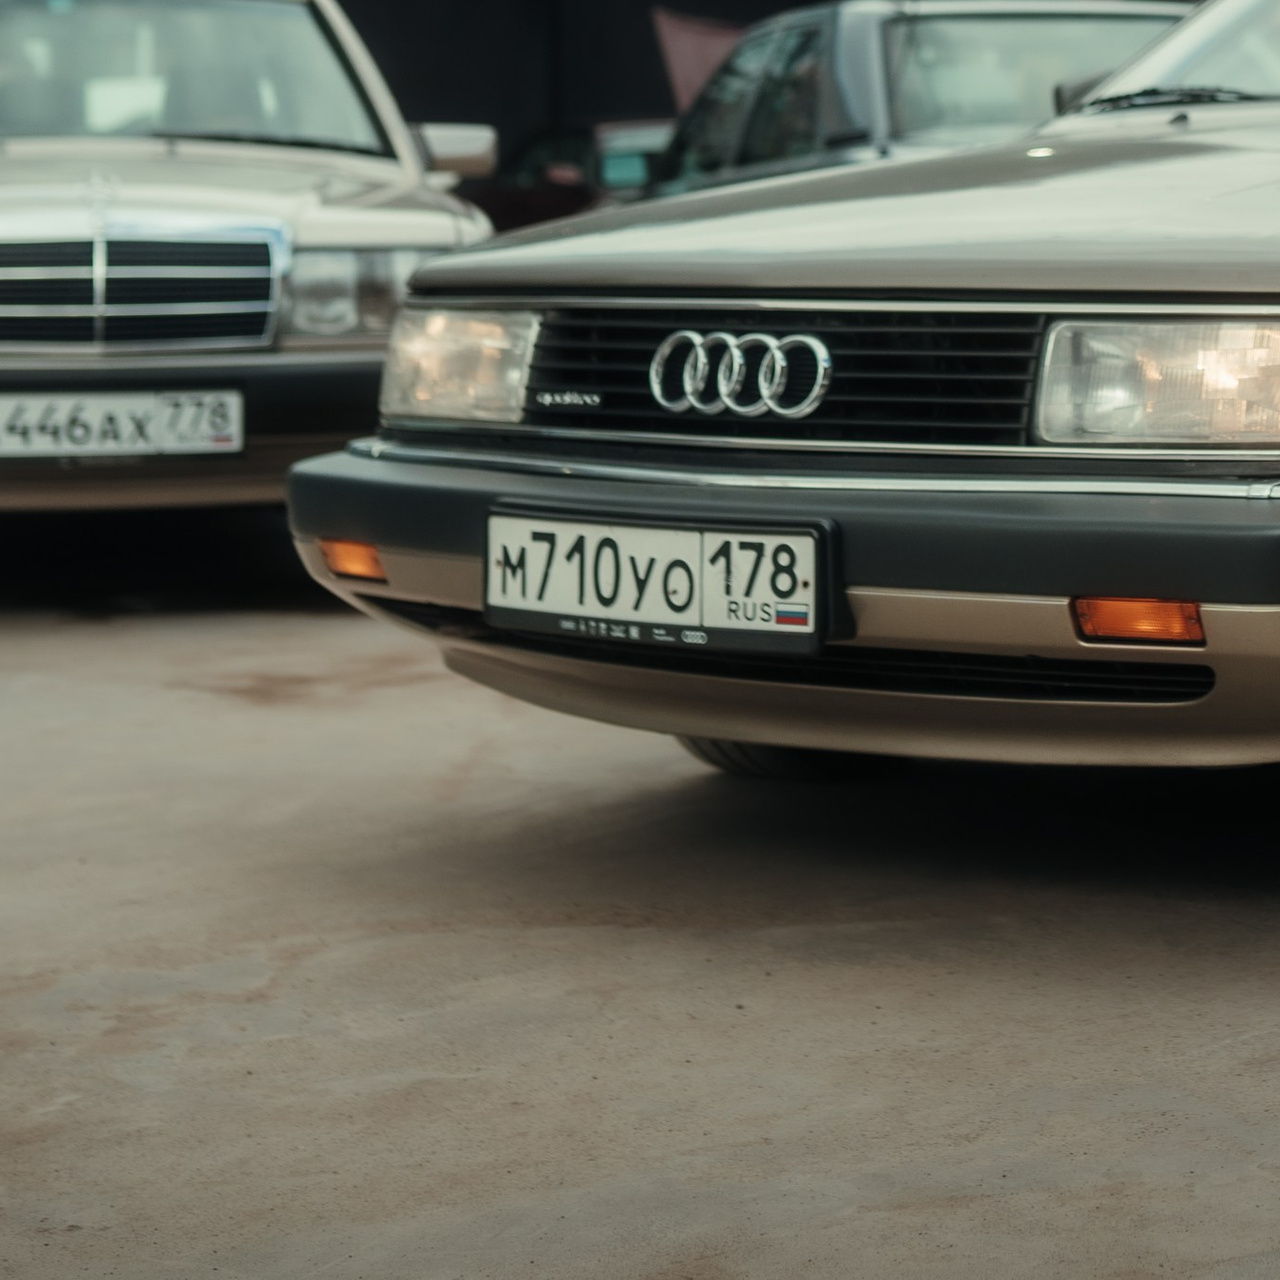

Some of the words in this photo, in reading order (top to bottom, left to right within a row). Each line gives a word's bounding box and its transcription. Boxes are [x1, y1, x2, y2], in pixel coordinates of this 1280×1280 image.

[0, 401, 152, 446] 446АХ
[709, 540, 798, 600] 178
[727, 601, 773, 621] RUS
